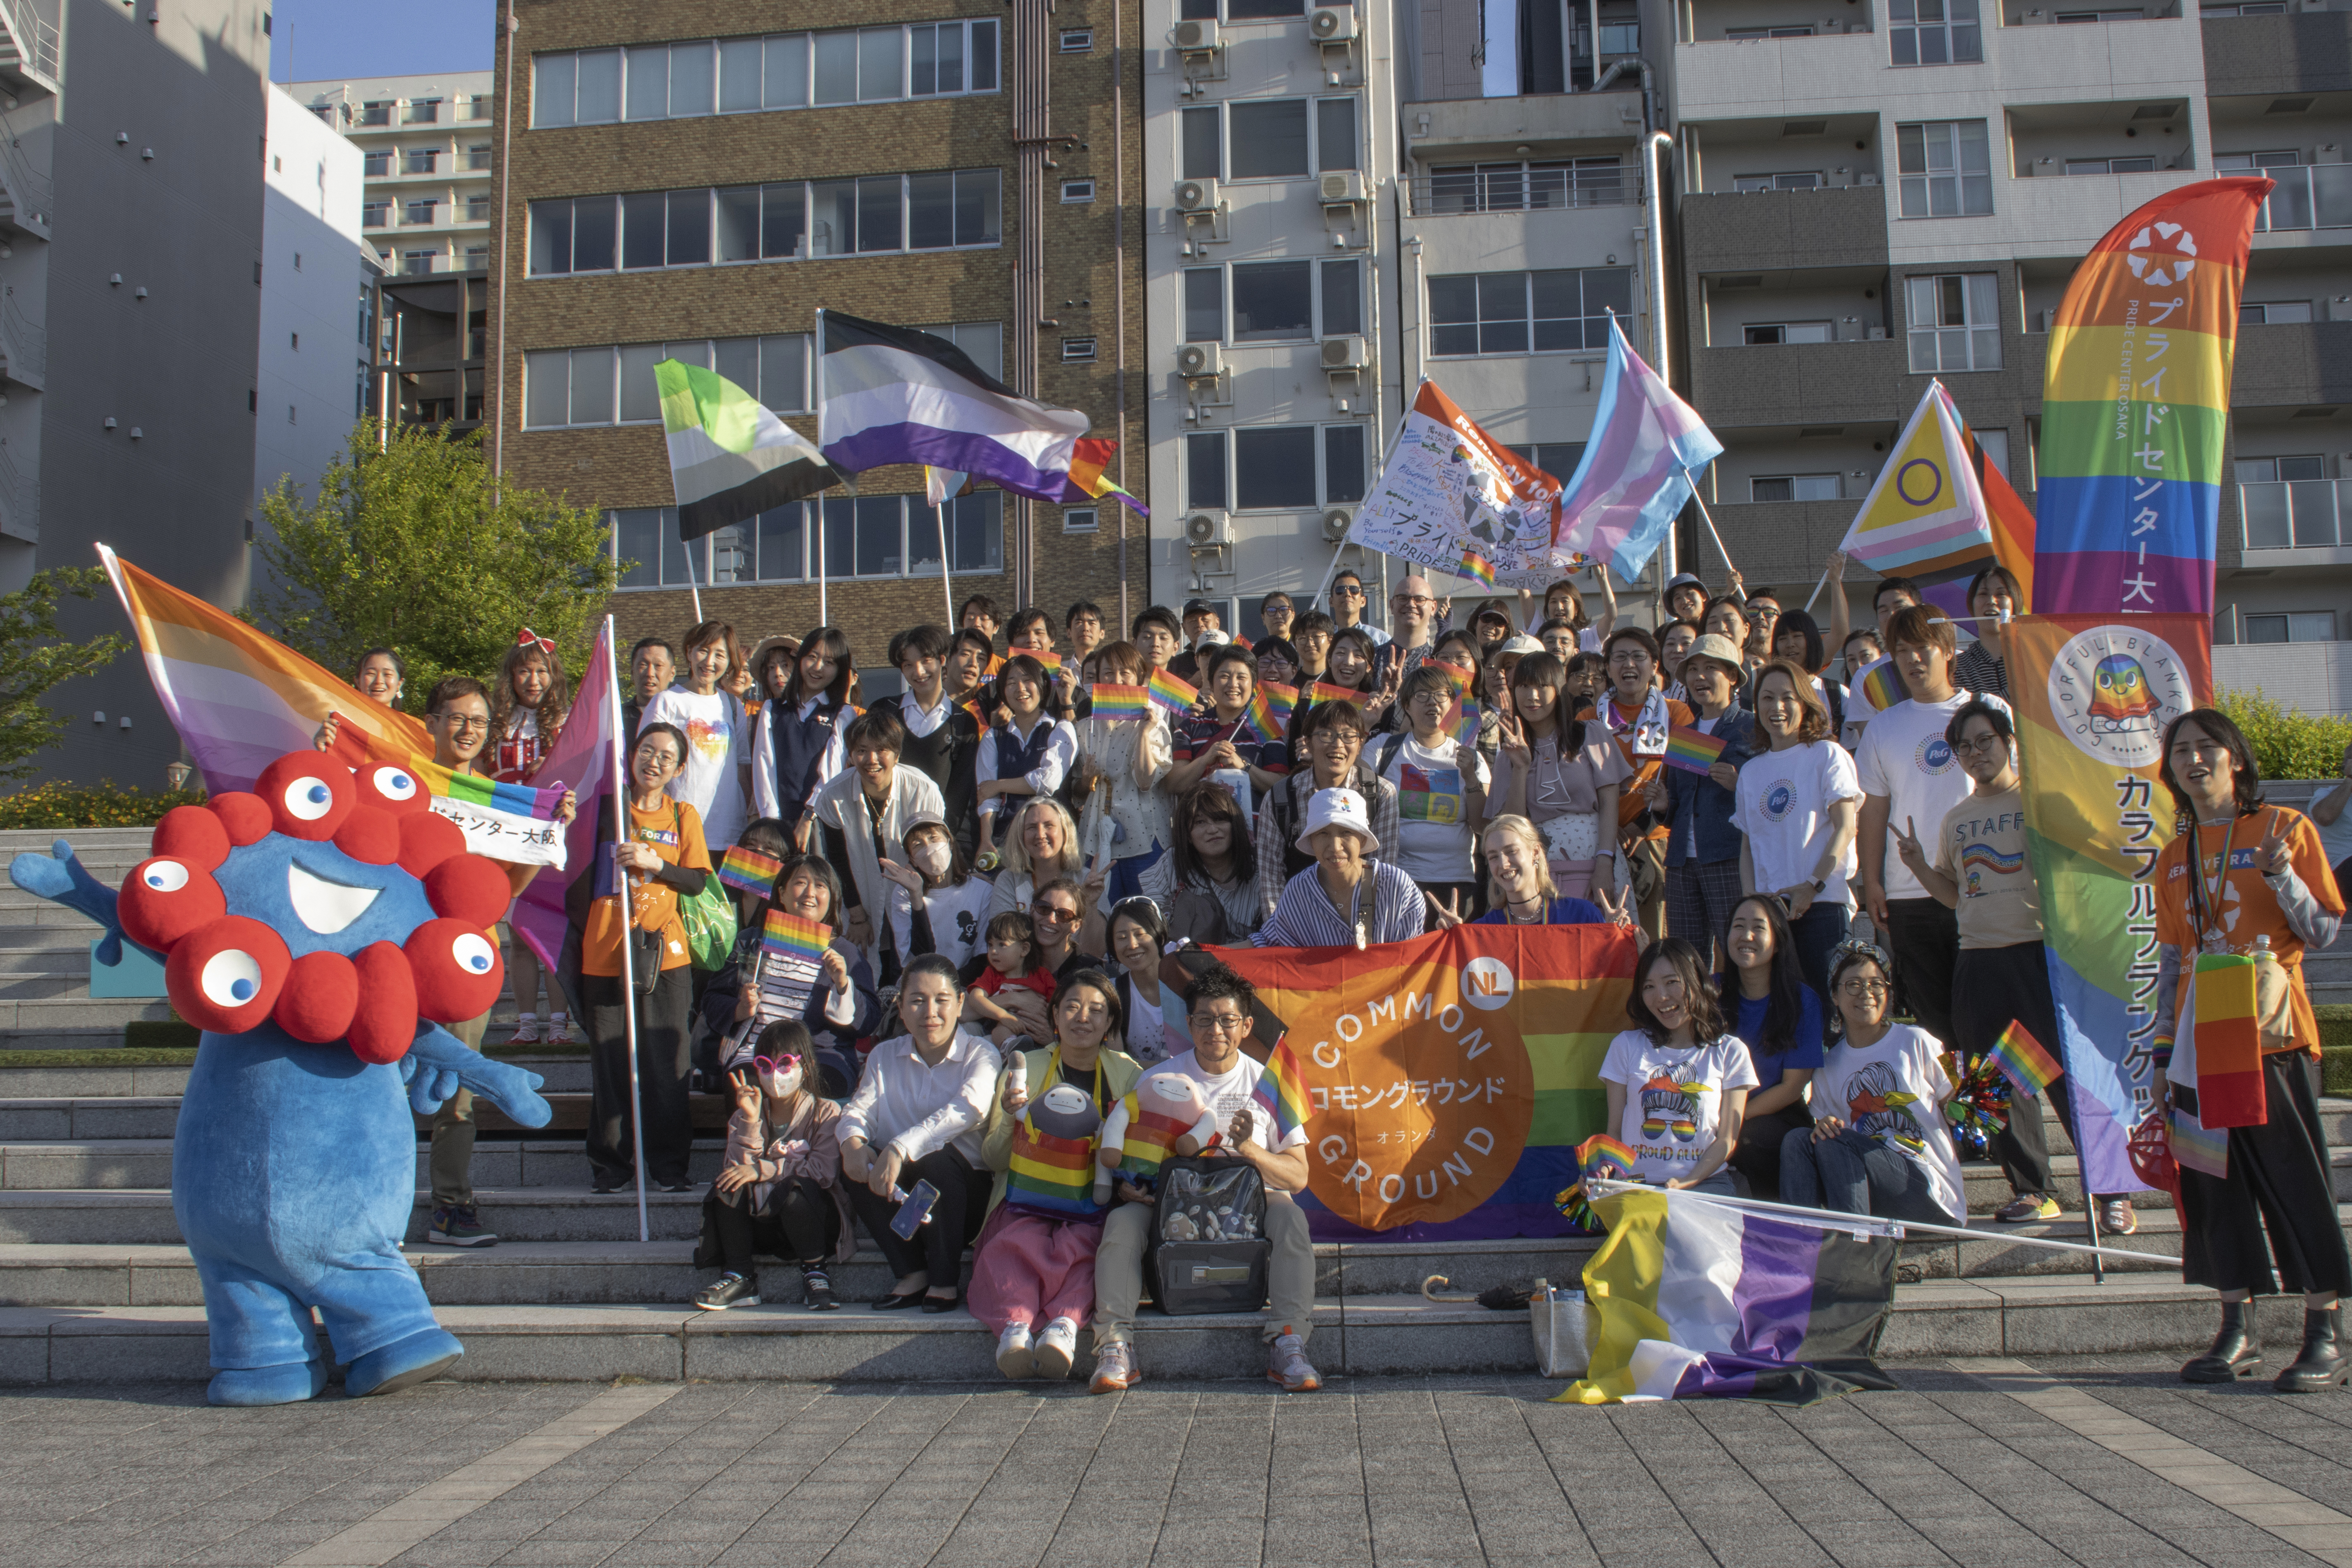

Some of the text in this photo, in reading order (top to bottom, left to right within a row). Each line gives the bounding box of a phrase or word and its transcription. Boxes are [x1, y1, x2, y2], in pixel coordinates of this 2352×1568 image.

[2116, 300, 2139, 440] PRIDE CENTER OSAKA
[1455, 415, 1528, 486] Remedy
[1527, 479, 1561, 502] for
[2122, 298, 2183, 612] プライドセンター大
[1368, 504, 1398, 519] ALLY
[1363, 519, 1373, 528] Be
[1362, 535, 1390, 551] Friendly
[1496, 540, 1523, 555] LOVE
[1496, 554, 1518, 569] LOVE
[2059, 638, 2105, 746] COLORFUL
[1929, 747, 1948, 760] P&G
[1771, 794, 1788, 806] P&G
[1955, 812, 2024, 842] STAFF
[641, 829, 660, 840] FOR
[662, 834, 678, 844] ALL
[1468, 971, 1509, 997] NL
[1312, 992, 1492, 1069] COMMON
[1310, 1077, 1506, 1111] コモングラウンド
[1376, 1127, 1437, 1144] オランダ
[1631, 1144, 1704, 1161] PROUD ALLY
[1318, 1126, 1495, 1204] GROUND
